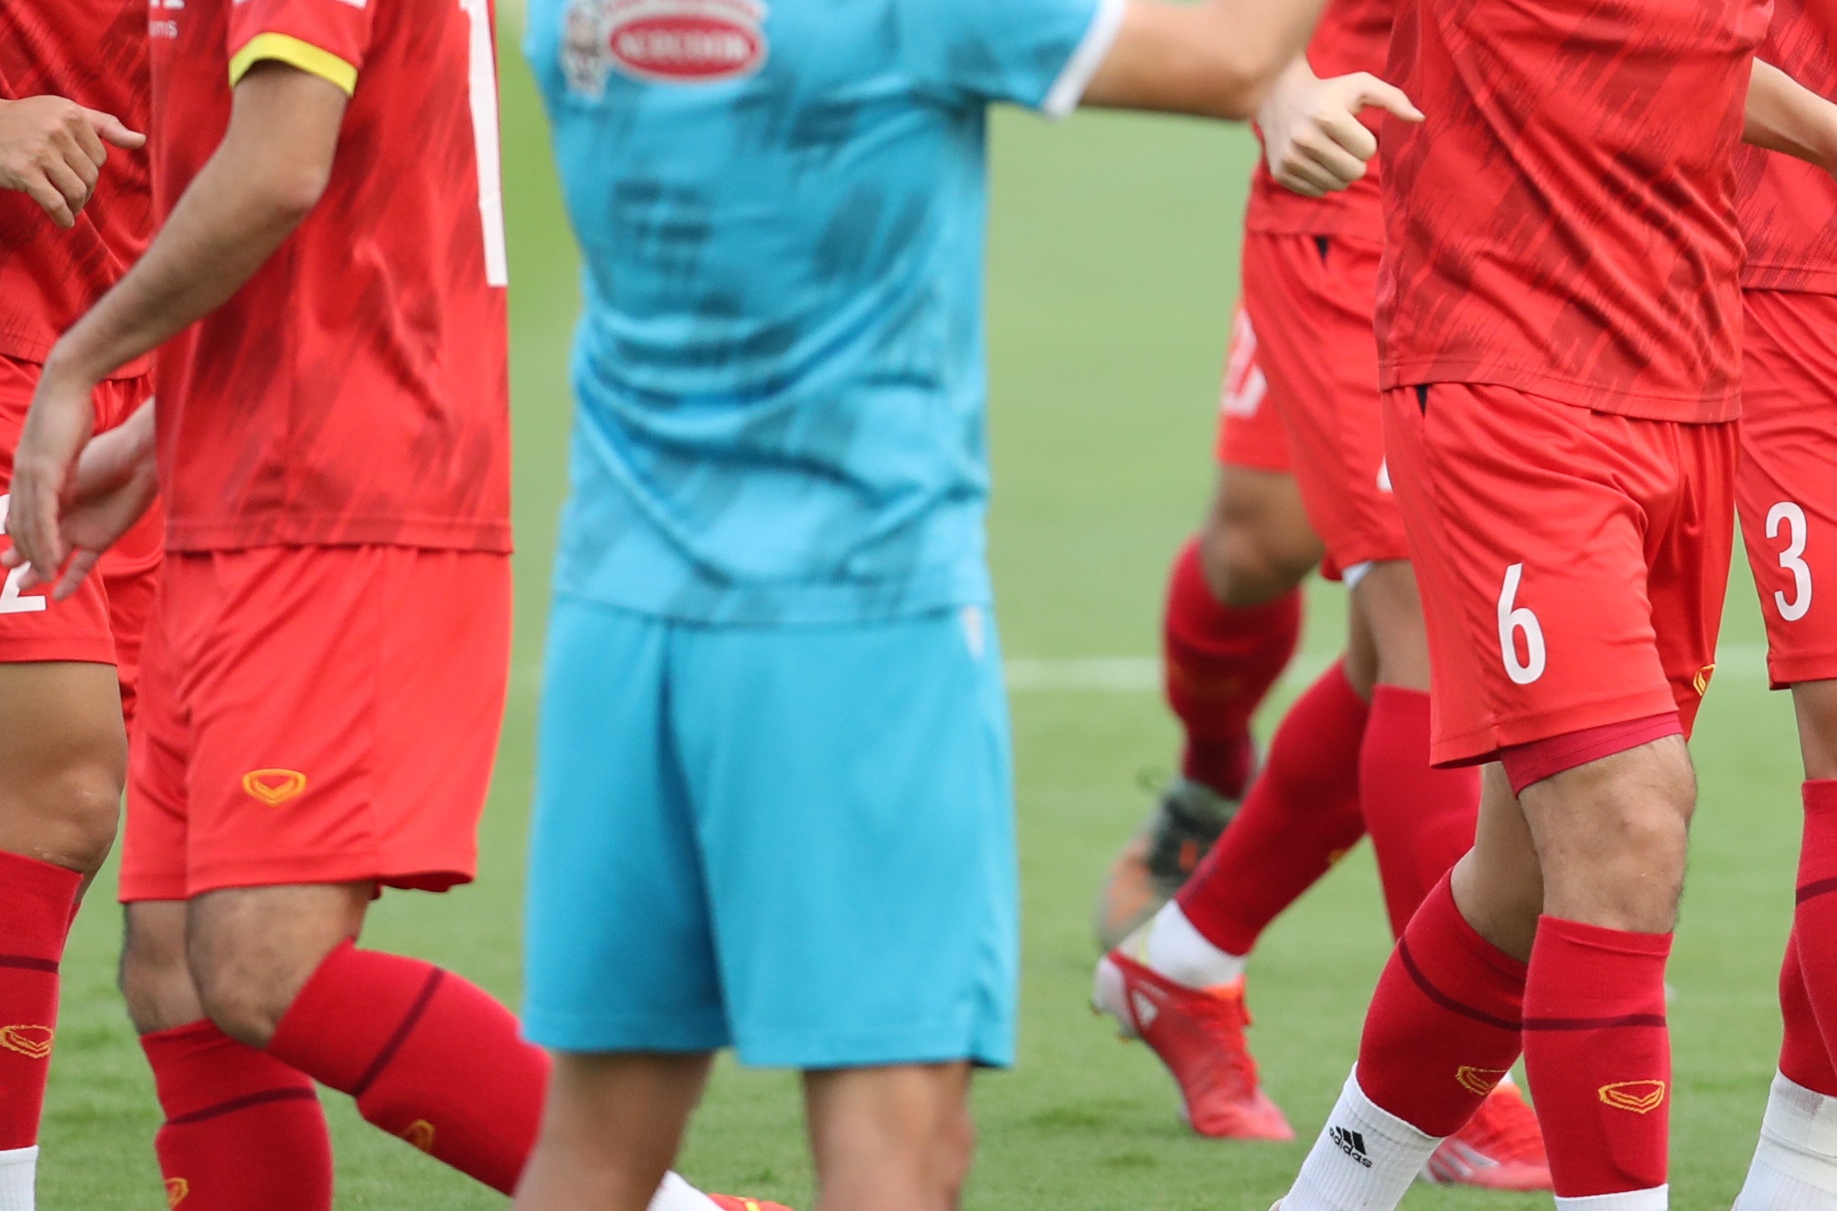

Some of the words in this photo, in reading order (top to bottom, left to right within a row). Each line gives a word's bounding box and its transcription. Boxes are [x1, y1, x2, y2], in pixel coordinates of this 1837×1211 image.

[1765, 501, 1813, 622] 3
[1497, 562, 1547, 685] 6
[1329, 1127, 1372, 1168] adidas
